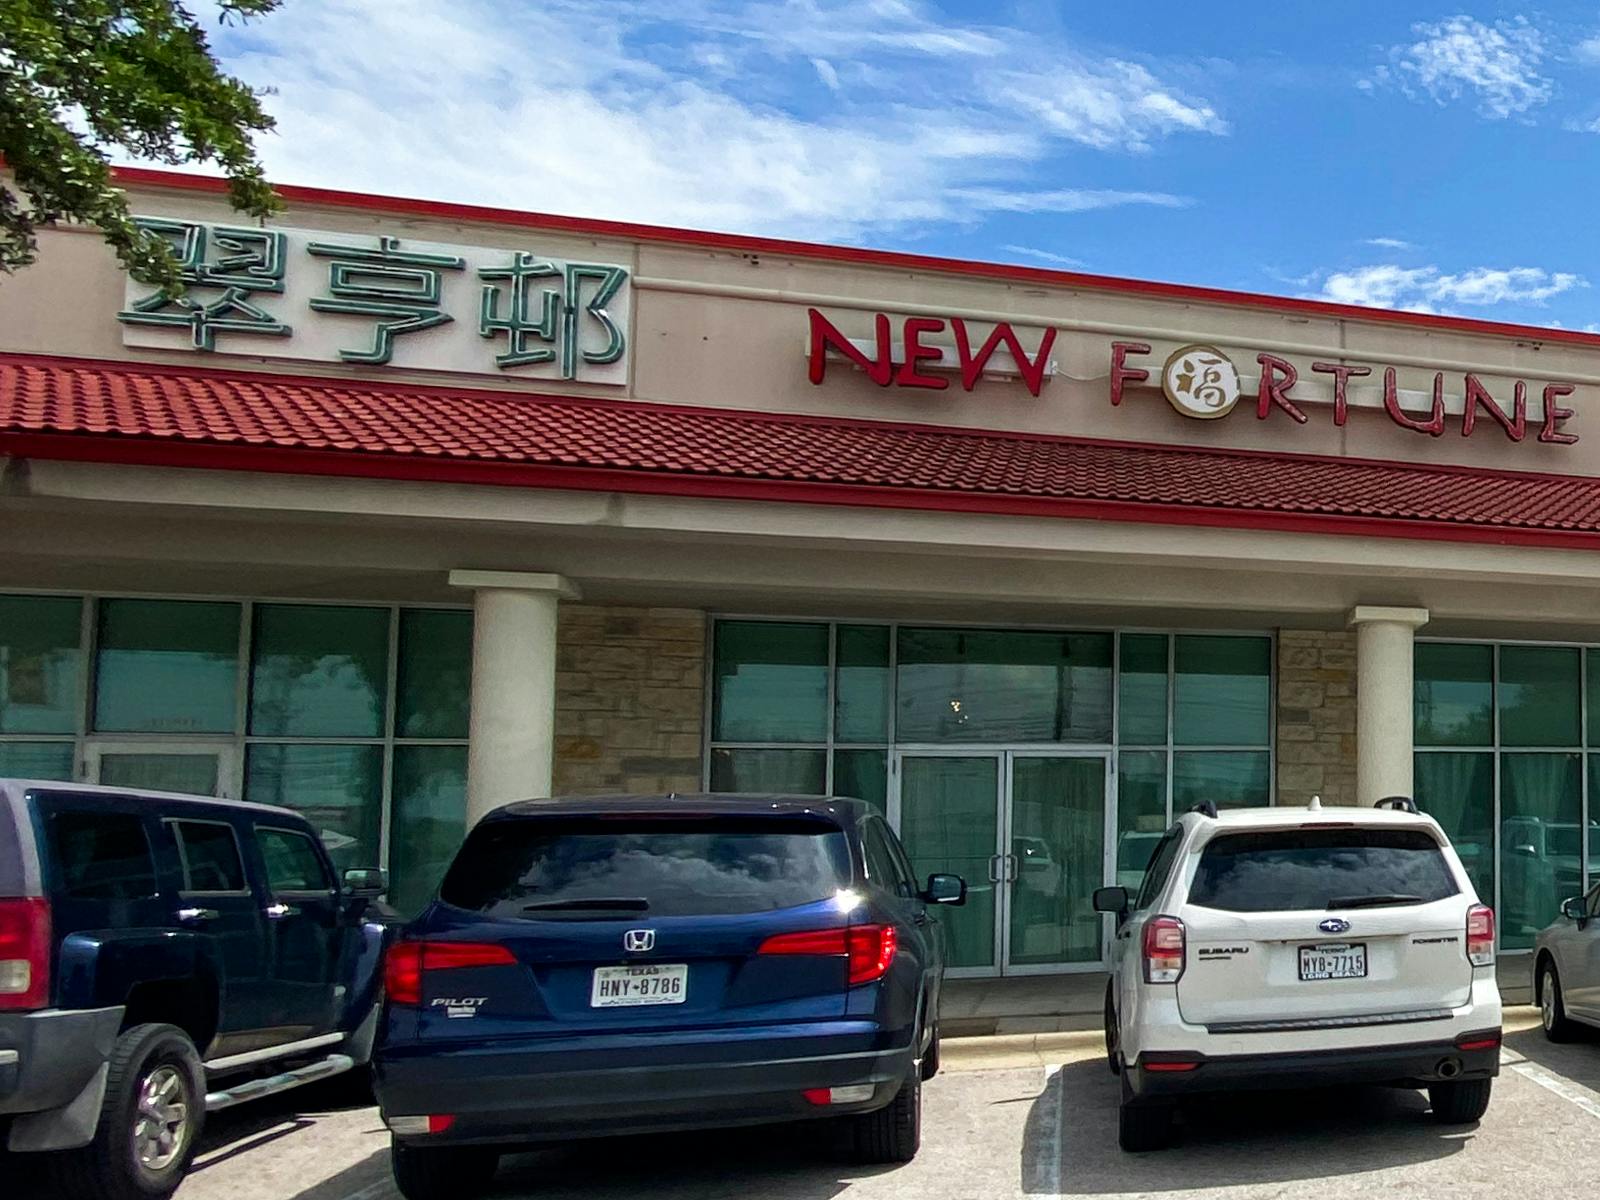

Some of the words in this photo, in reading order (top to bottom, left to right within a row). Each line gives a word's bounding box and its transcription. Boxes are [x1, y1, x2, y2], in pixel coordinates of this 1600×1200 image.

[808, 308, 1057, 397] NEW
[1198, 947, 1250, 955] SUBARU
[625, 966, 660, 977] TEXAS
[431, 997, 489, 1006] PILOT
